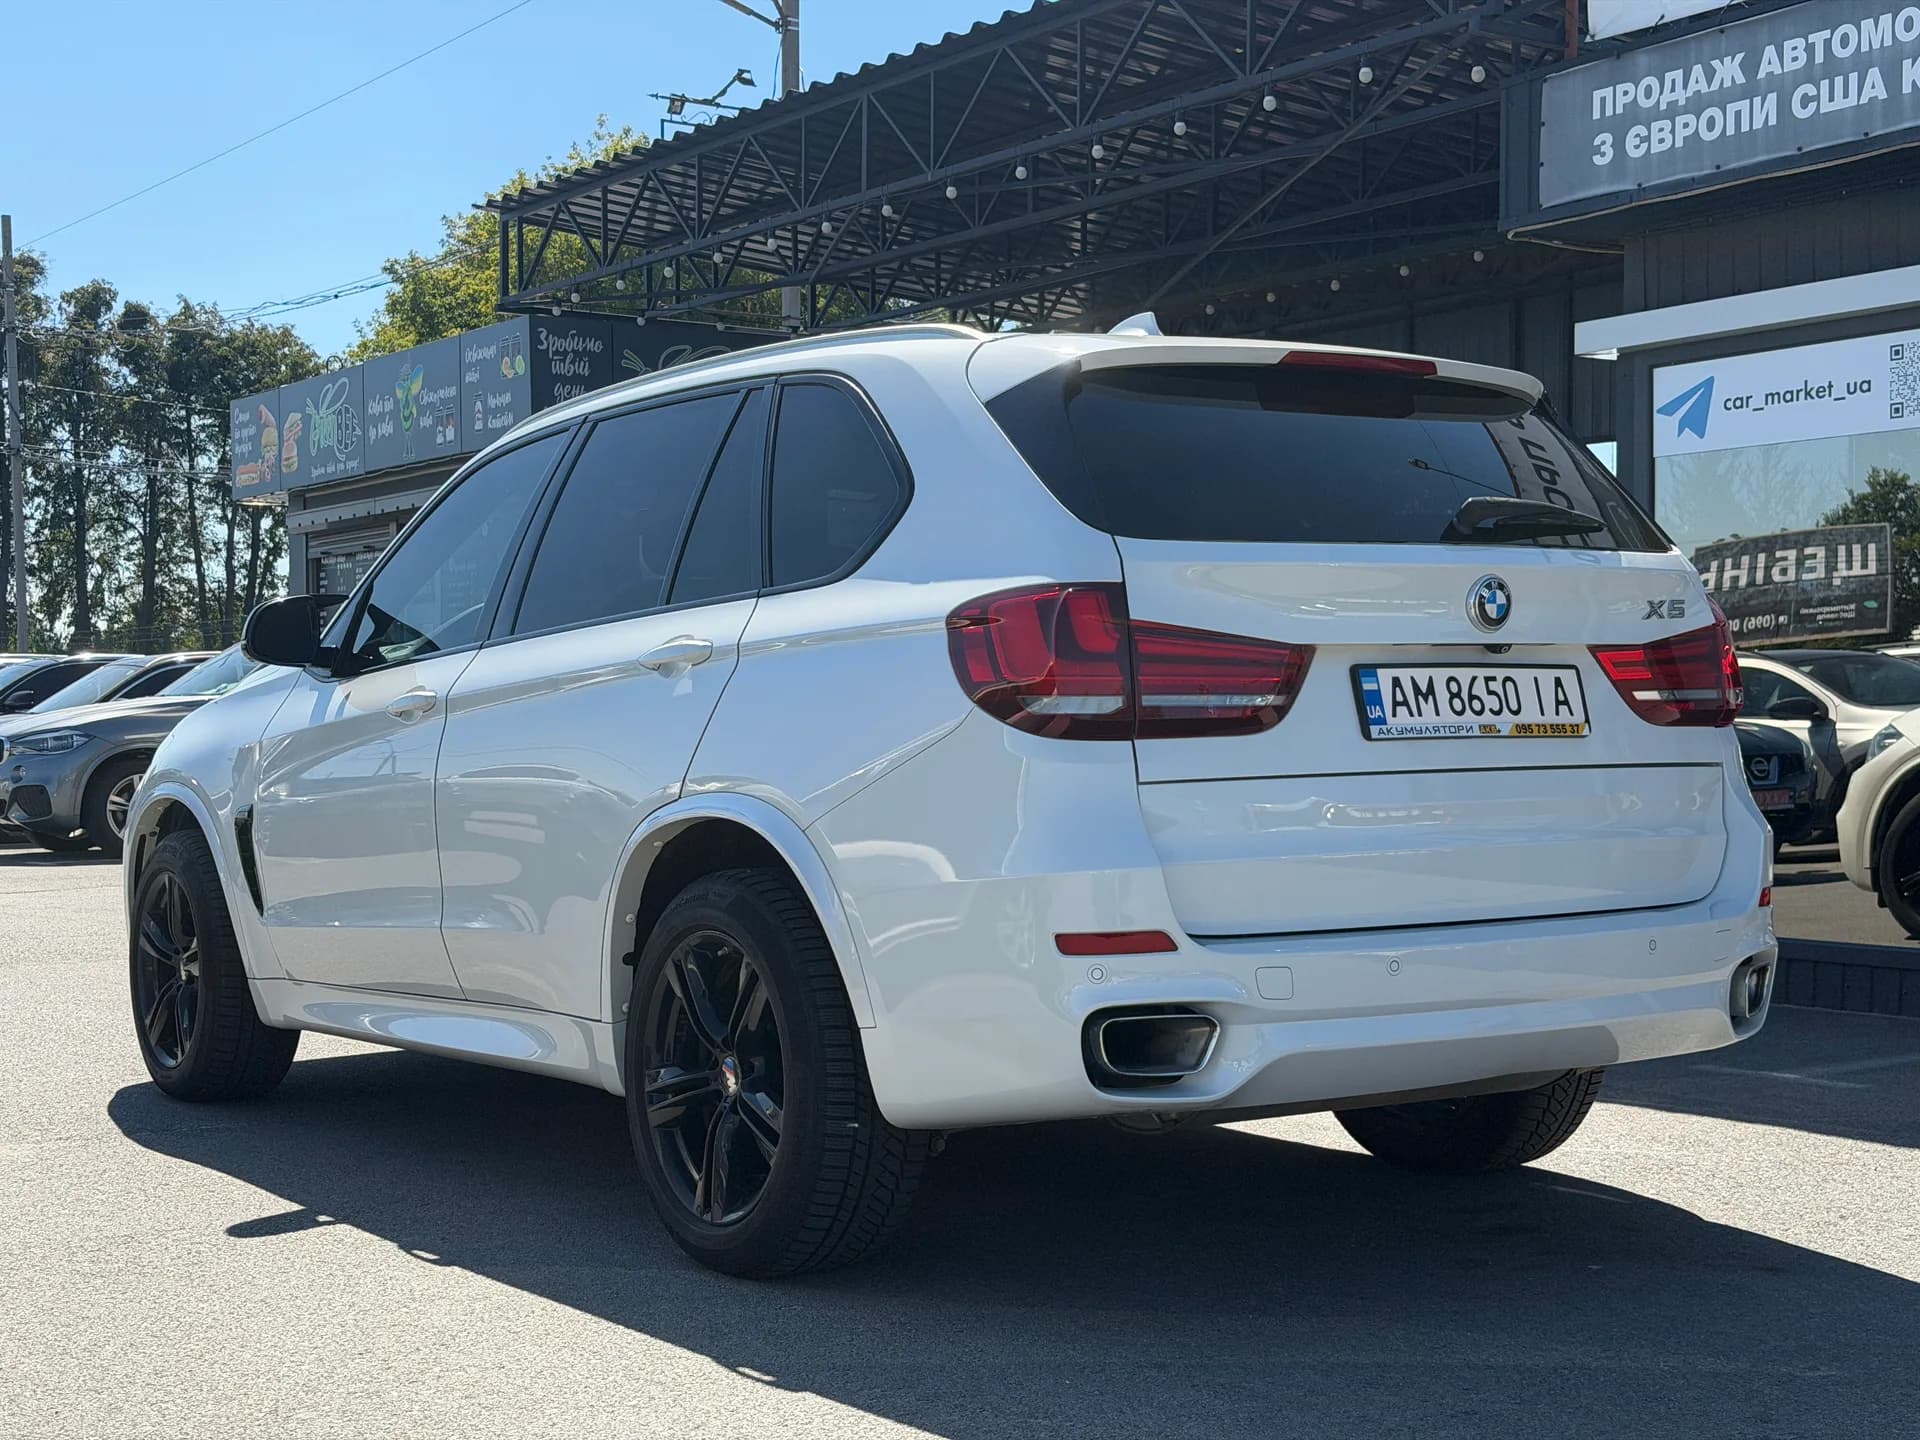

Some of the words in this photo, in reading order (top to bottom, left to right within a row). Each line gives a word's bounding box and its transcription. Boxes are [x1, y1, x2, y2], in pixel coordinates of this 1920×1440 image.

[1592, 52, 1746, 120] ПРОДАЖ
[1756, 6, 1920, 80] АВТОМО
[1592, 132, 1614, 166] З
[1625, 92, 1777, 158] ЄВРОПИ
[1791, 66, 1888, 119] США
[537, 327, 603, 359] Зробимо
[552, 354, 591, 377] твій
[1723, 378, 1871, 412] car_market_ua
[1641, 600, 1686, 620] X5
[1367, 705, 1384, 719] UA
[1391, 676, 1440, 717] AM
[1445, 676, 1522, 717] 8650
[1377, 725, 1474, 737] АКУМУЛЯТОРИ
[1515, 723, 1534, 734] 095
[1535, 723, 1548, 734] 73
[1550, 723, 1567, 734] 555
[1569, 723, 1580, 734] 37
